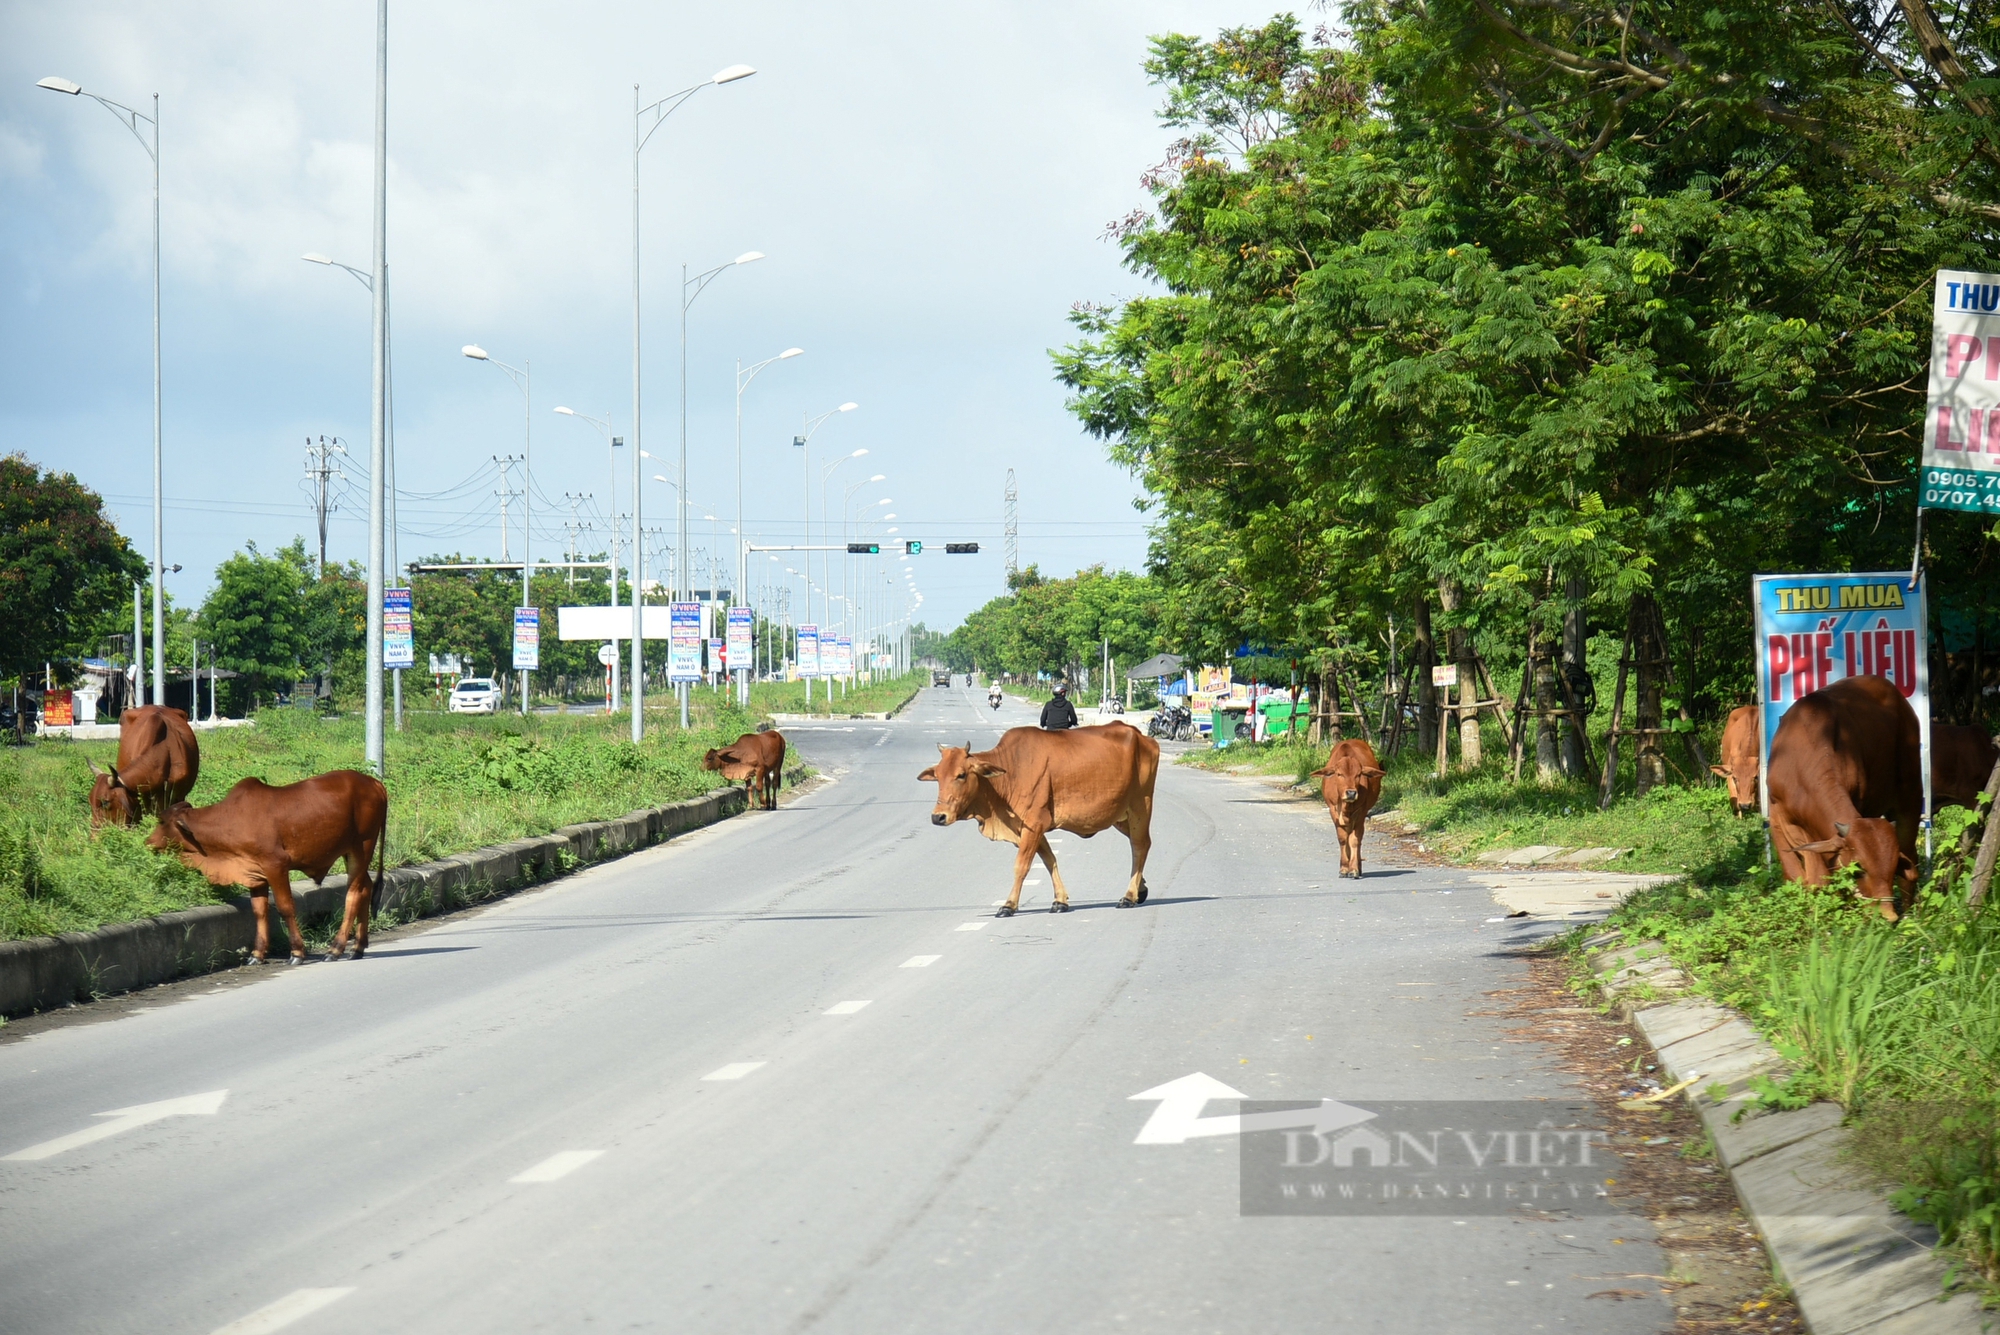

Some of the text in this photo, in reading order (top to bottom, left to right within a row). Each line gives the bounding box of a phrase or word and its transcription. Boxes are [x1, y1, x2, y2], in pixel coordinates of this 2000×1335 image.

[1946, 281, 1999, 312] THU
[1775, 584, 1904, 610] THU MUA
